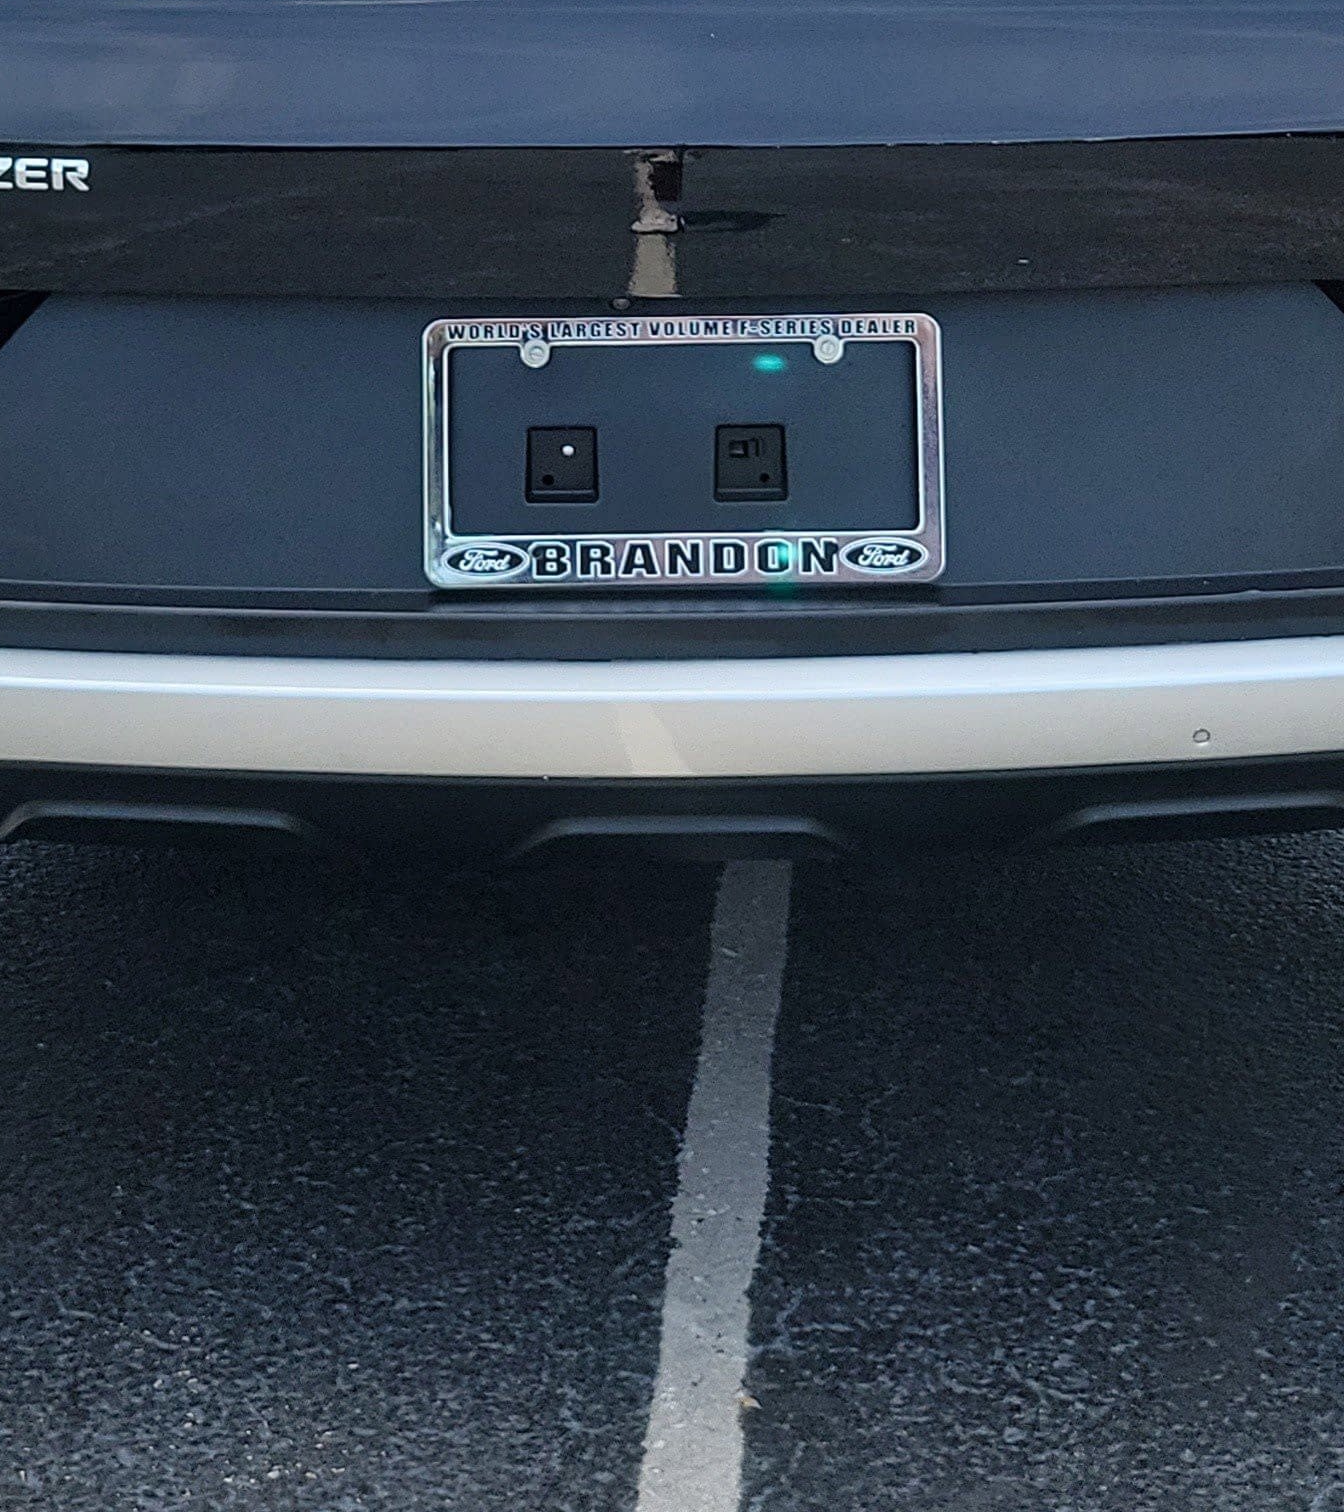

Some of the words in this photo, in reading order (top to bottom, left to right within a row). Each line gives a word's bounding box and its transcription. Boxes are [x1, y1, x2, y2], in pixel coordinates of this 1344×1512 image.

[446, 323, 542, 340] WORLD'S
[548, 321, 641, 338] LARGEST
[648, 320, 732, 337] VOLUME
[739, 319, 832, 336] F-SERIES
[840, 319, 917, 335] DEALER
[457, 546, 512, 573] Ford
[531, 538, 839, 579] BRANDON
[856, 544, 911, 570] Ford
